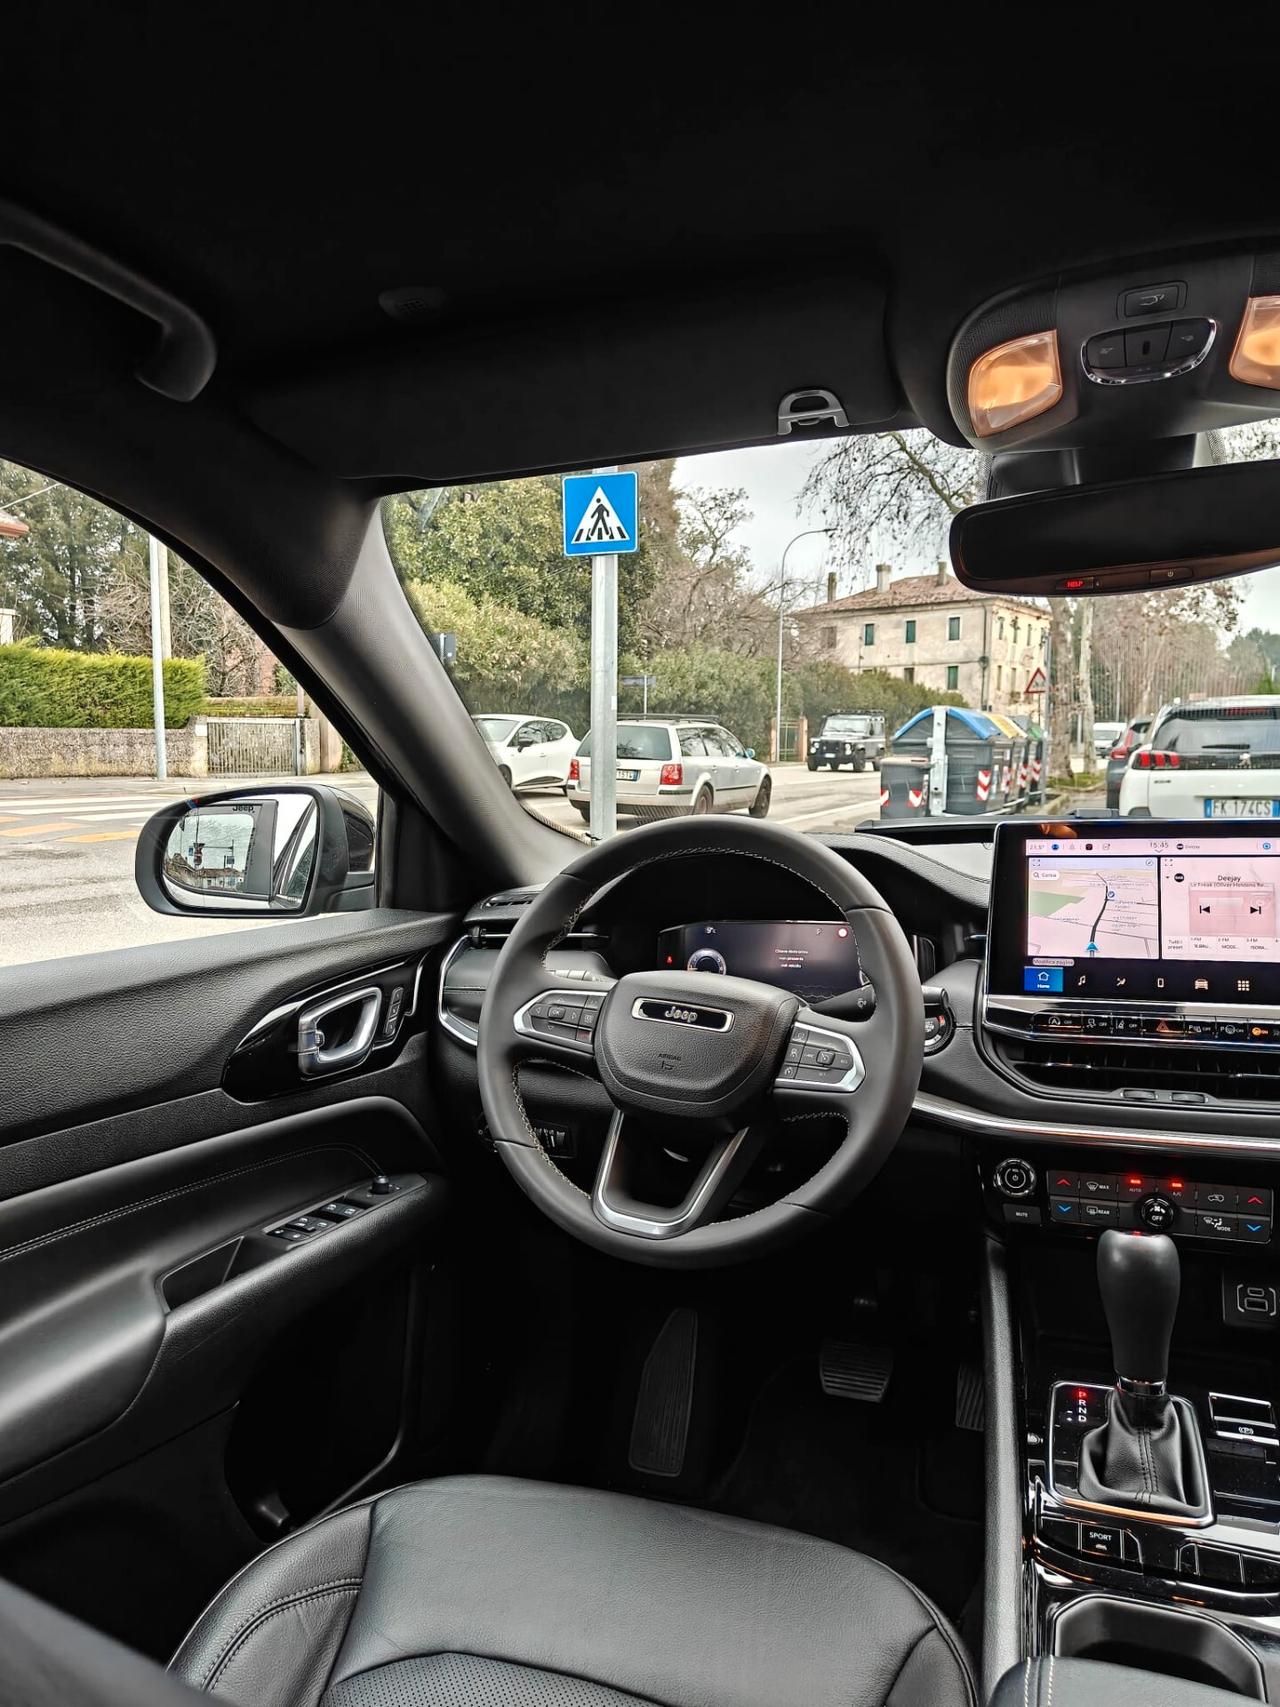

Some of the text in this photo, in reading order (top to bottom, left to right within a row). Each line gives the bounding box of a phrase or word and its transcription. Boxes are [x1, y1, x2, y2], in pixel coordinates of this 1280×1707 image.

[1217, 874, 1241, 883] Deejay
[664, 1006, 698, 1023] Jeep
[1089, 1531, 1112, 1541] SPORT
